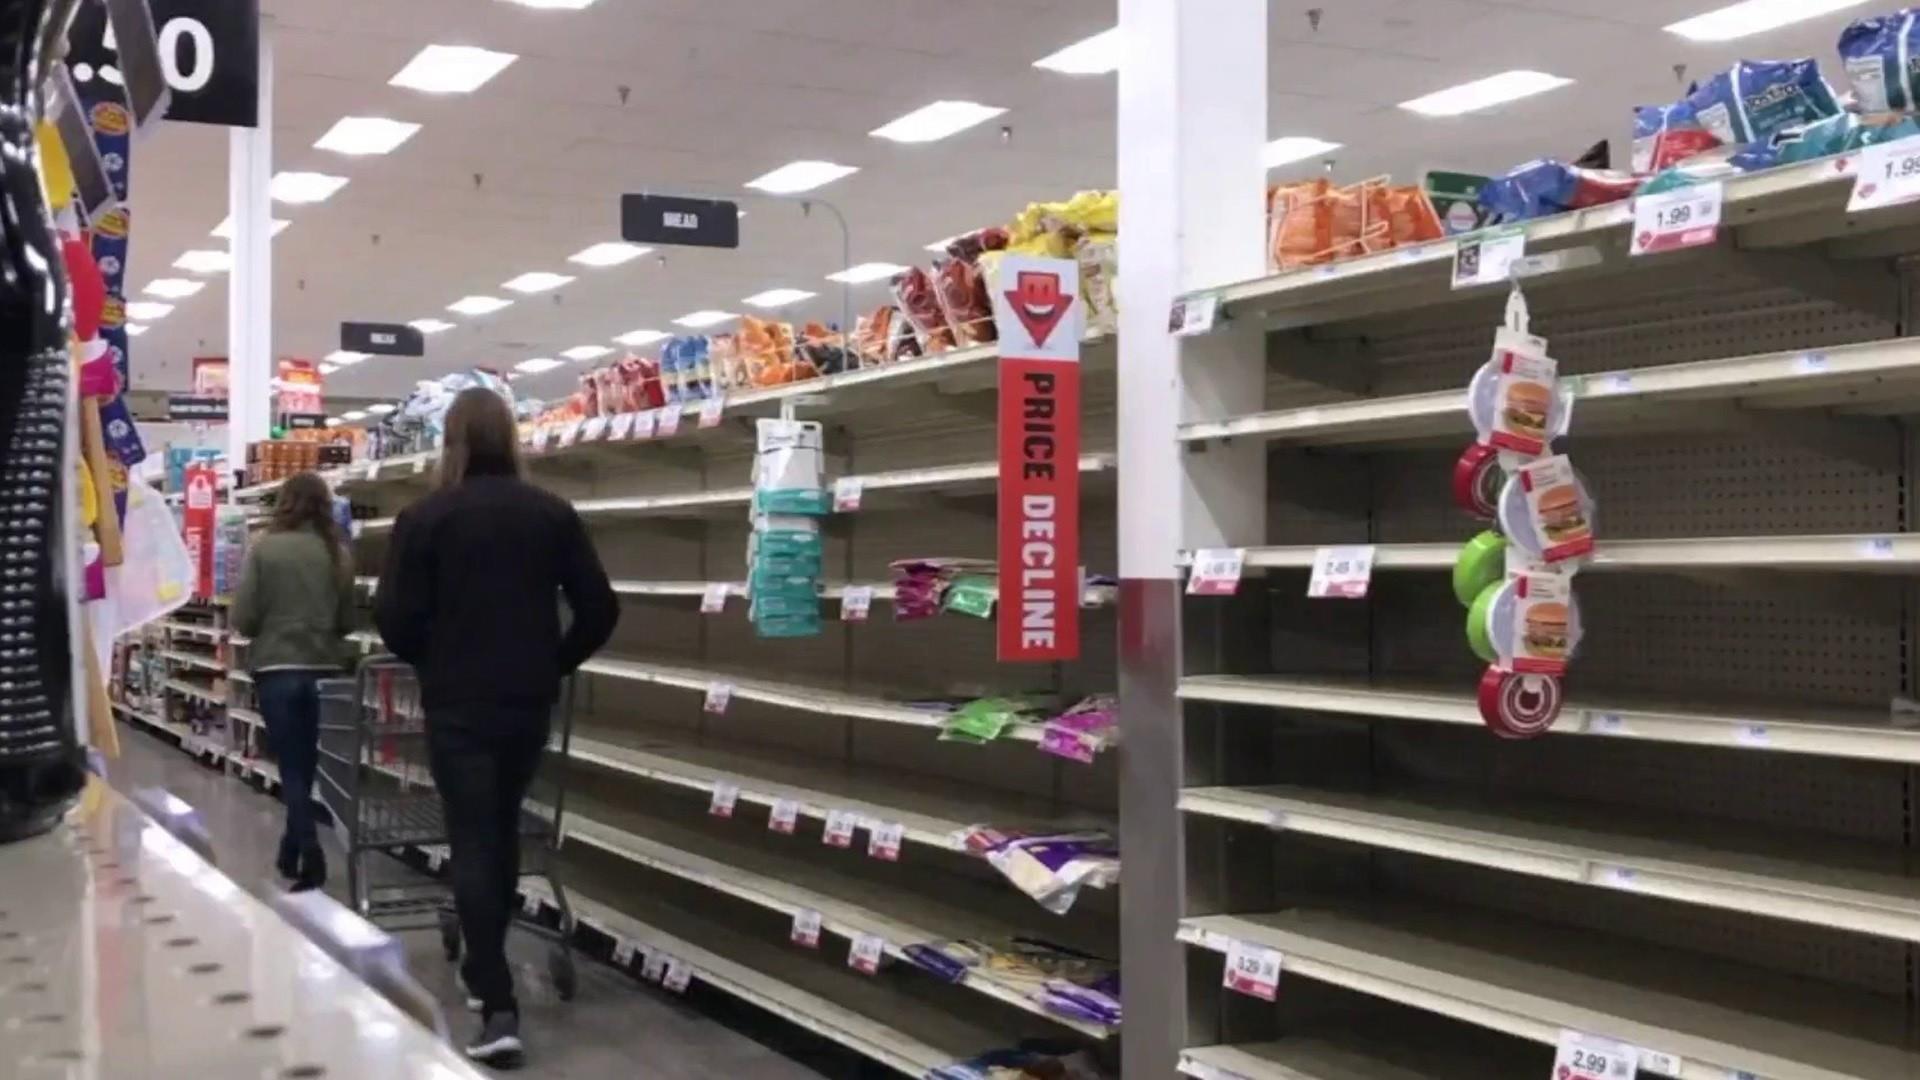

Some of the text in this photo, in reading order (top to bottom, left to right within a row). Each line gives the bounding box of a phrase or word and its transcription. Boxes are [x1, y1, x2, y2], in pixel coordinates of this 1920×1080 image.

[1657, 205, 1690, 226] 1.99
[1022, 373, 1055, 649] PRICE DECLINE
[1573, 1050, 1607, 1073] 2.99
